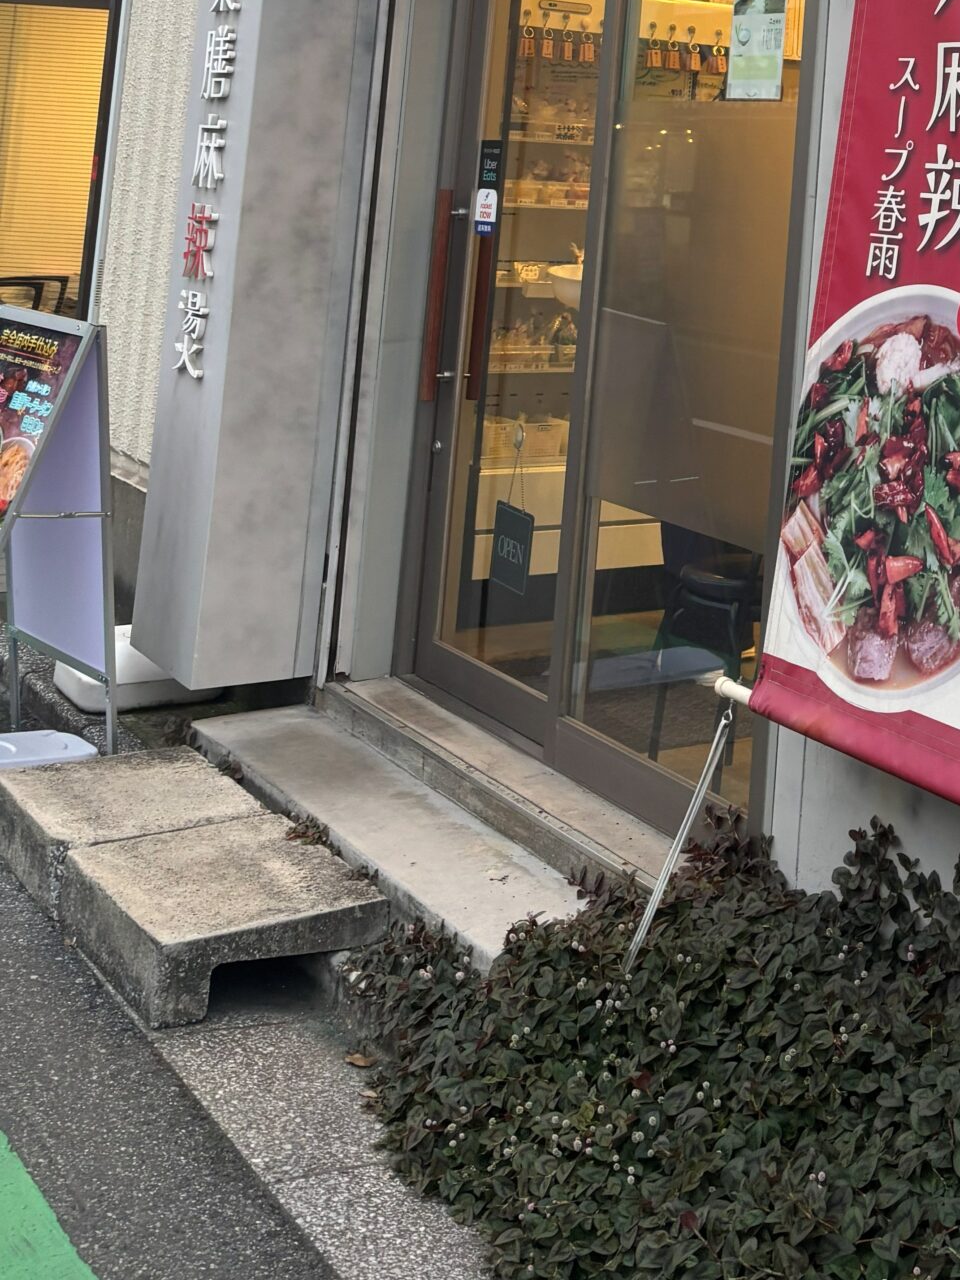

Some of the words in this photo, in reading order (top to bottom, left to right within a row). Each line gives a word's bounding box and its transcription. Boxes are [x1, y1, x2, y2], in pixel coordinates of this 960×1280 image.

[483, 158, 498, 170] Uber
[866, 57, 921, 281] スープ春雨
[483, 169, 497, 181] Eats
[498, 534, 525, 565] OPEN
